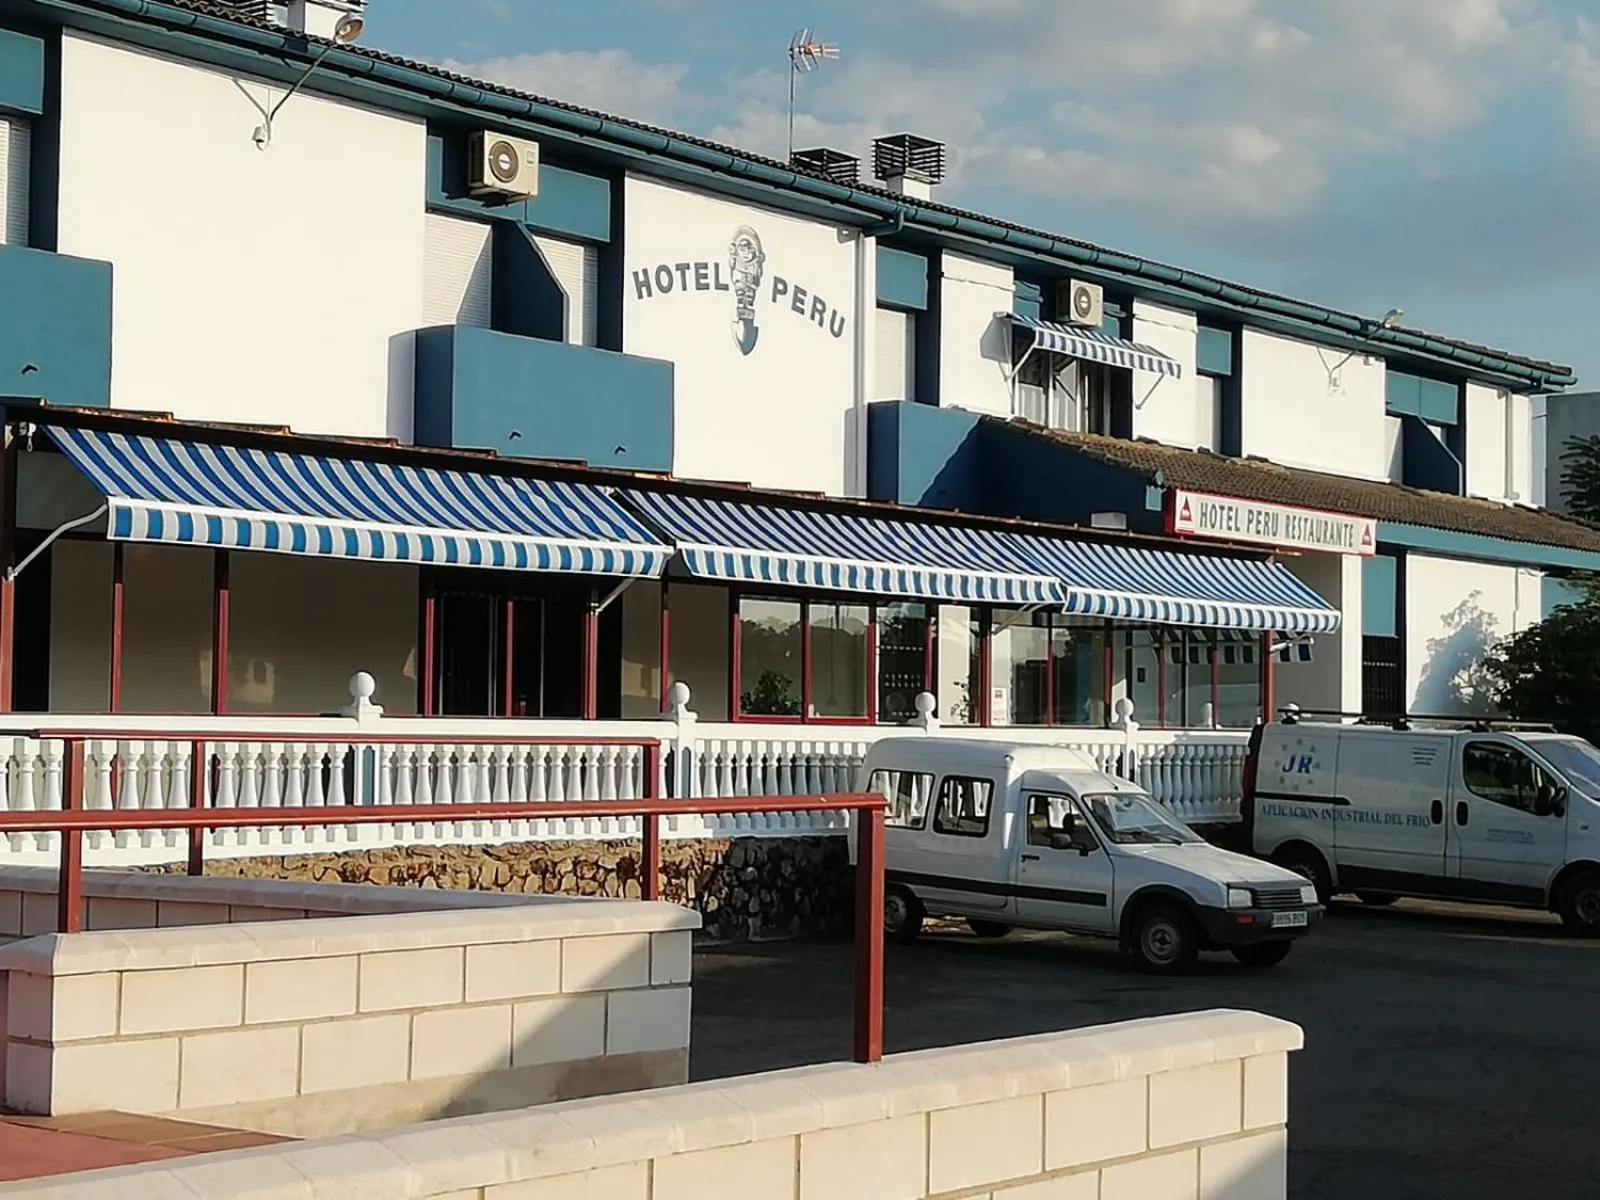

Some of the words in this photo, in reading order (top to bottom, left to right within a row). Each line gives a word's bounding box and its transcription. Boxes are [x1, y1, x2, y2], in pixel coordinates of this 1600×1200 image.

[632, 262, 729, 300] HOTEL
[771, 276, 846, 339] PERU
[1199, 502, 1241, 532] HOTEL
[1246, 509, 1279, 537] PERU
[1285, 514, 1354, 547] RESTAURANTE
[1282, 755, 1313, 774] JR
[1321, 808, 1382, 825] INDUSTRIAL
[1384, 812, 1404, 826] DEL
